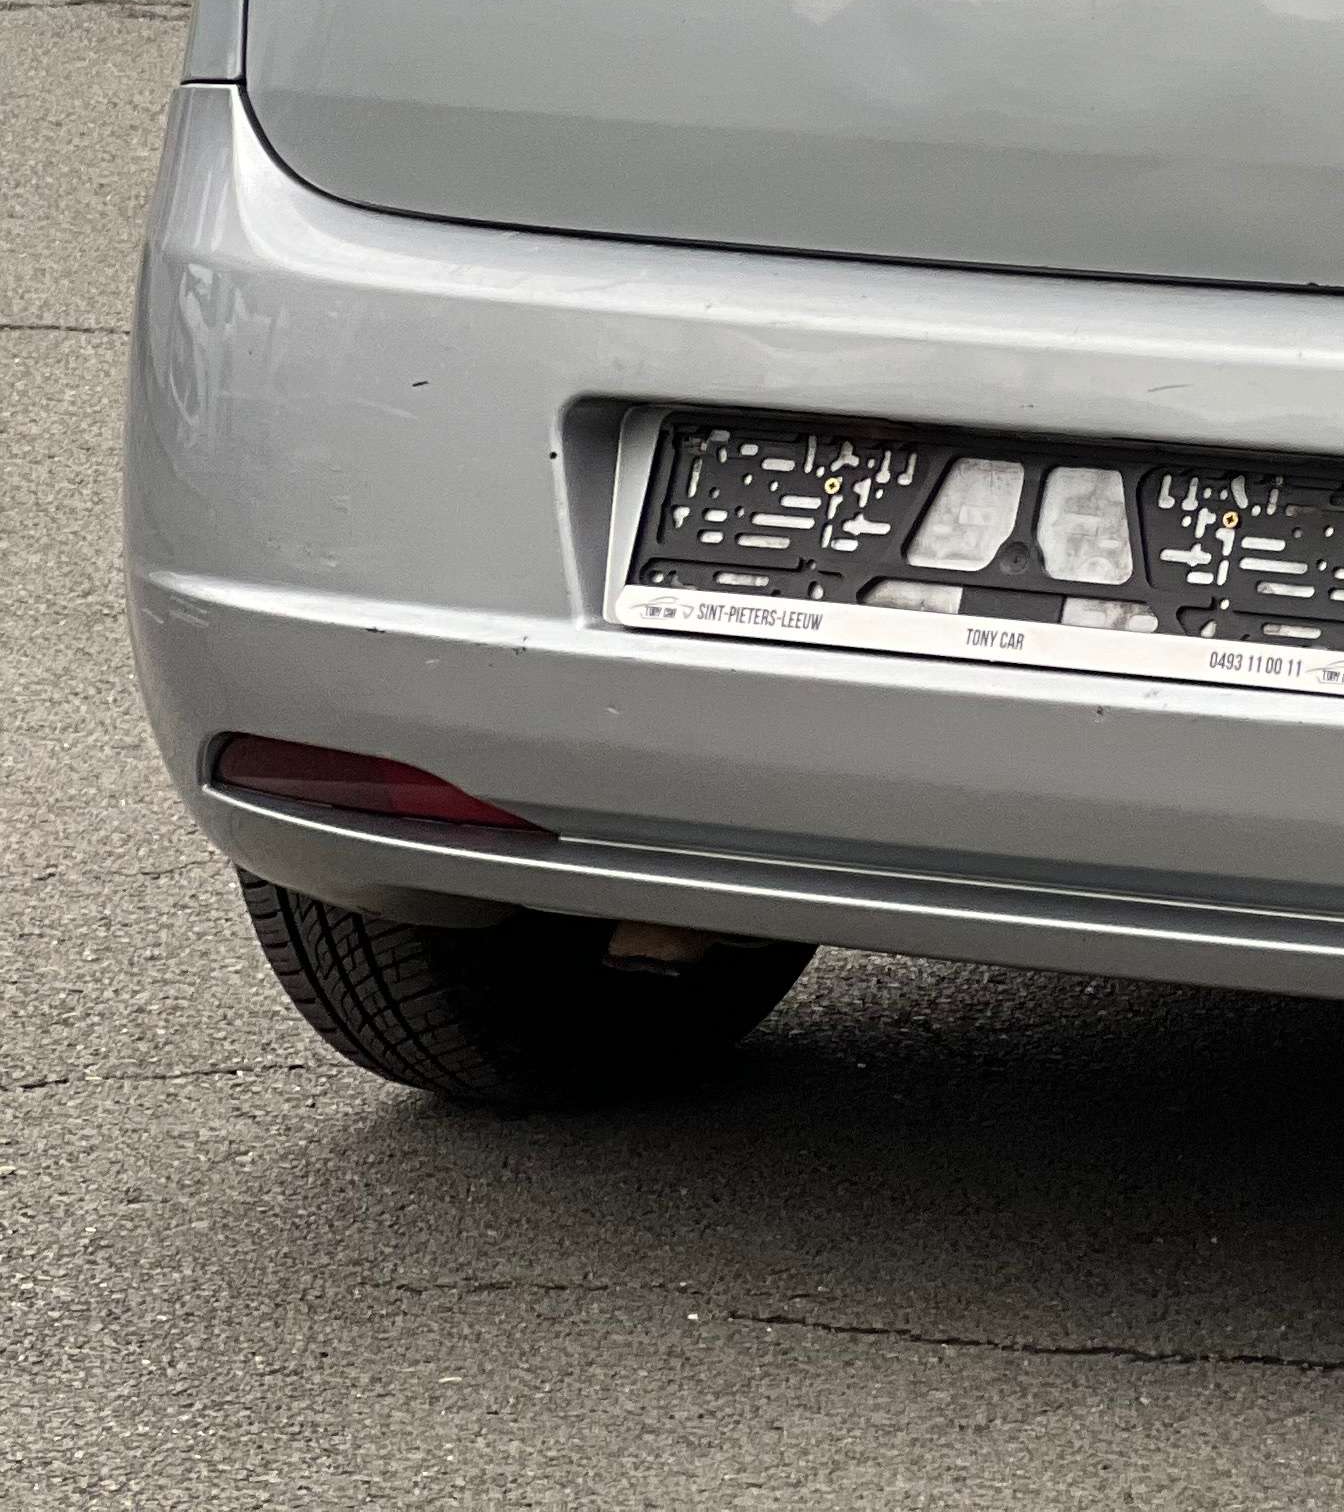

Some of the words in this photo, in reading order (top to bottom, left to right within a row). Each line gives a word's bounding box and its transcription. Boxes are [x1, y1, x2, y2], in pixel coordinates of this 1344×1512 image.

[697, 603, 824, 631] SINT-PIETERS-LEEUW
[966, 628, 998, 647] TONY
[1000, 631, 1024, 650] CAR
[1209, 651, 1243, 671] 0493
[1248, 655, 1262, 673] 11
[1265, 657, 1283, 675] 00
[1287, 659, 1302, 678] 11
